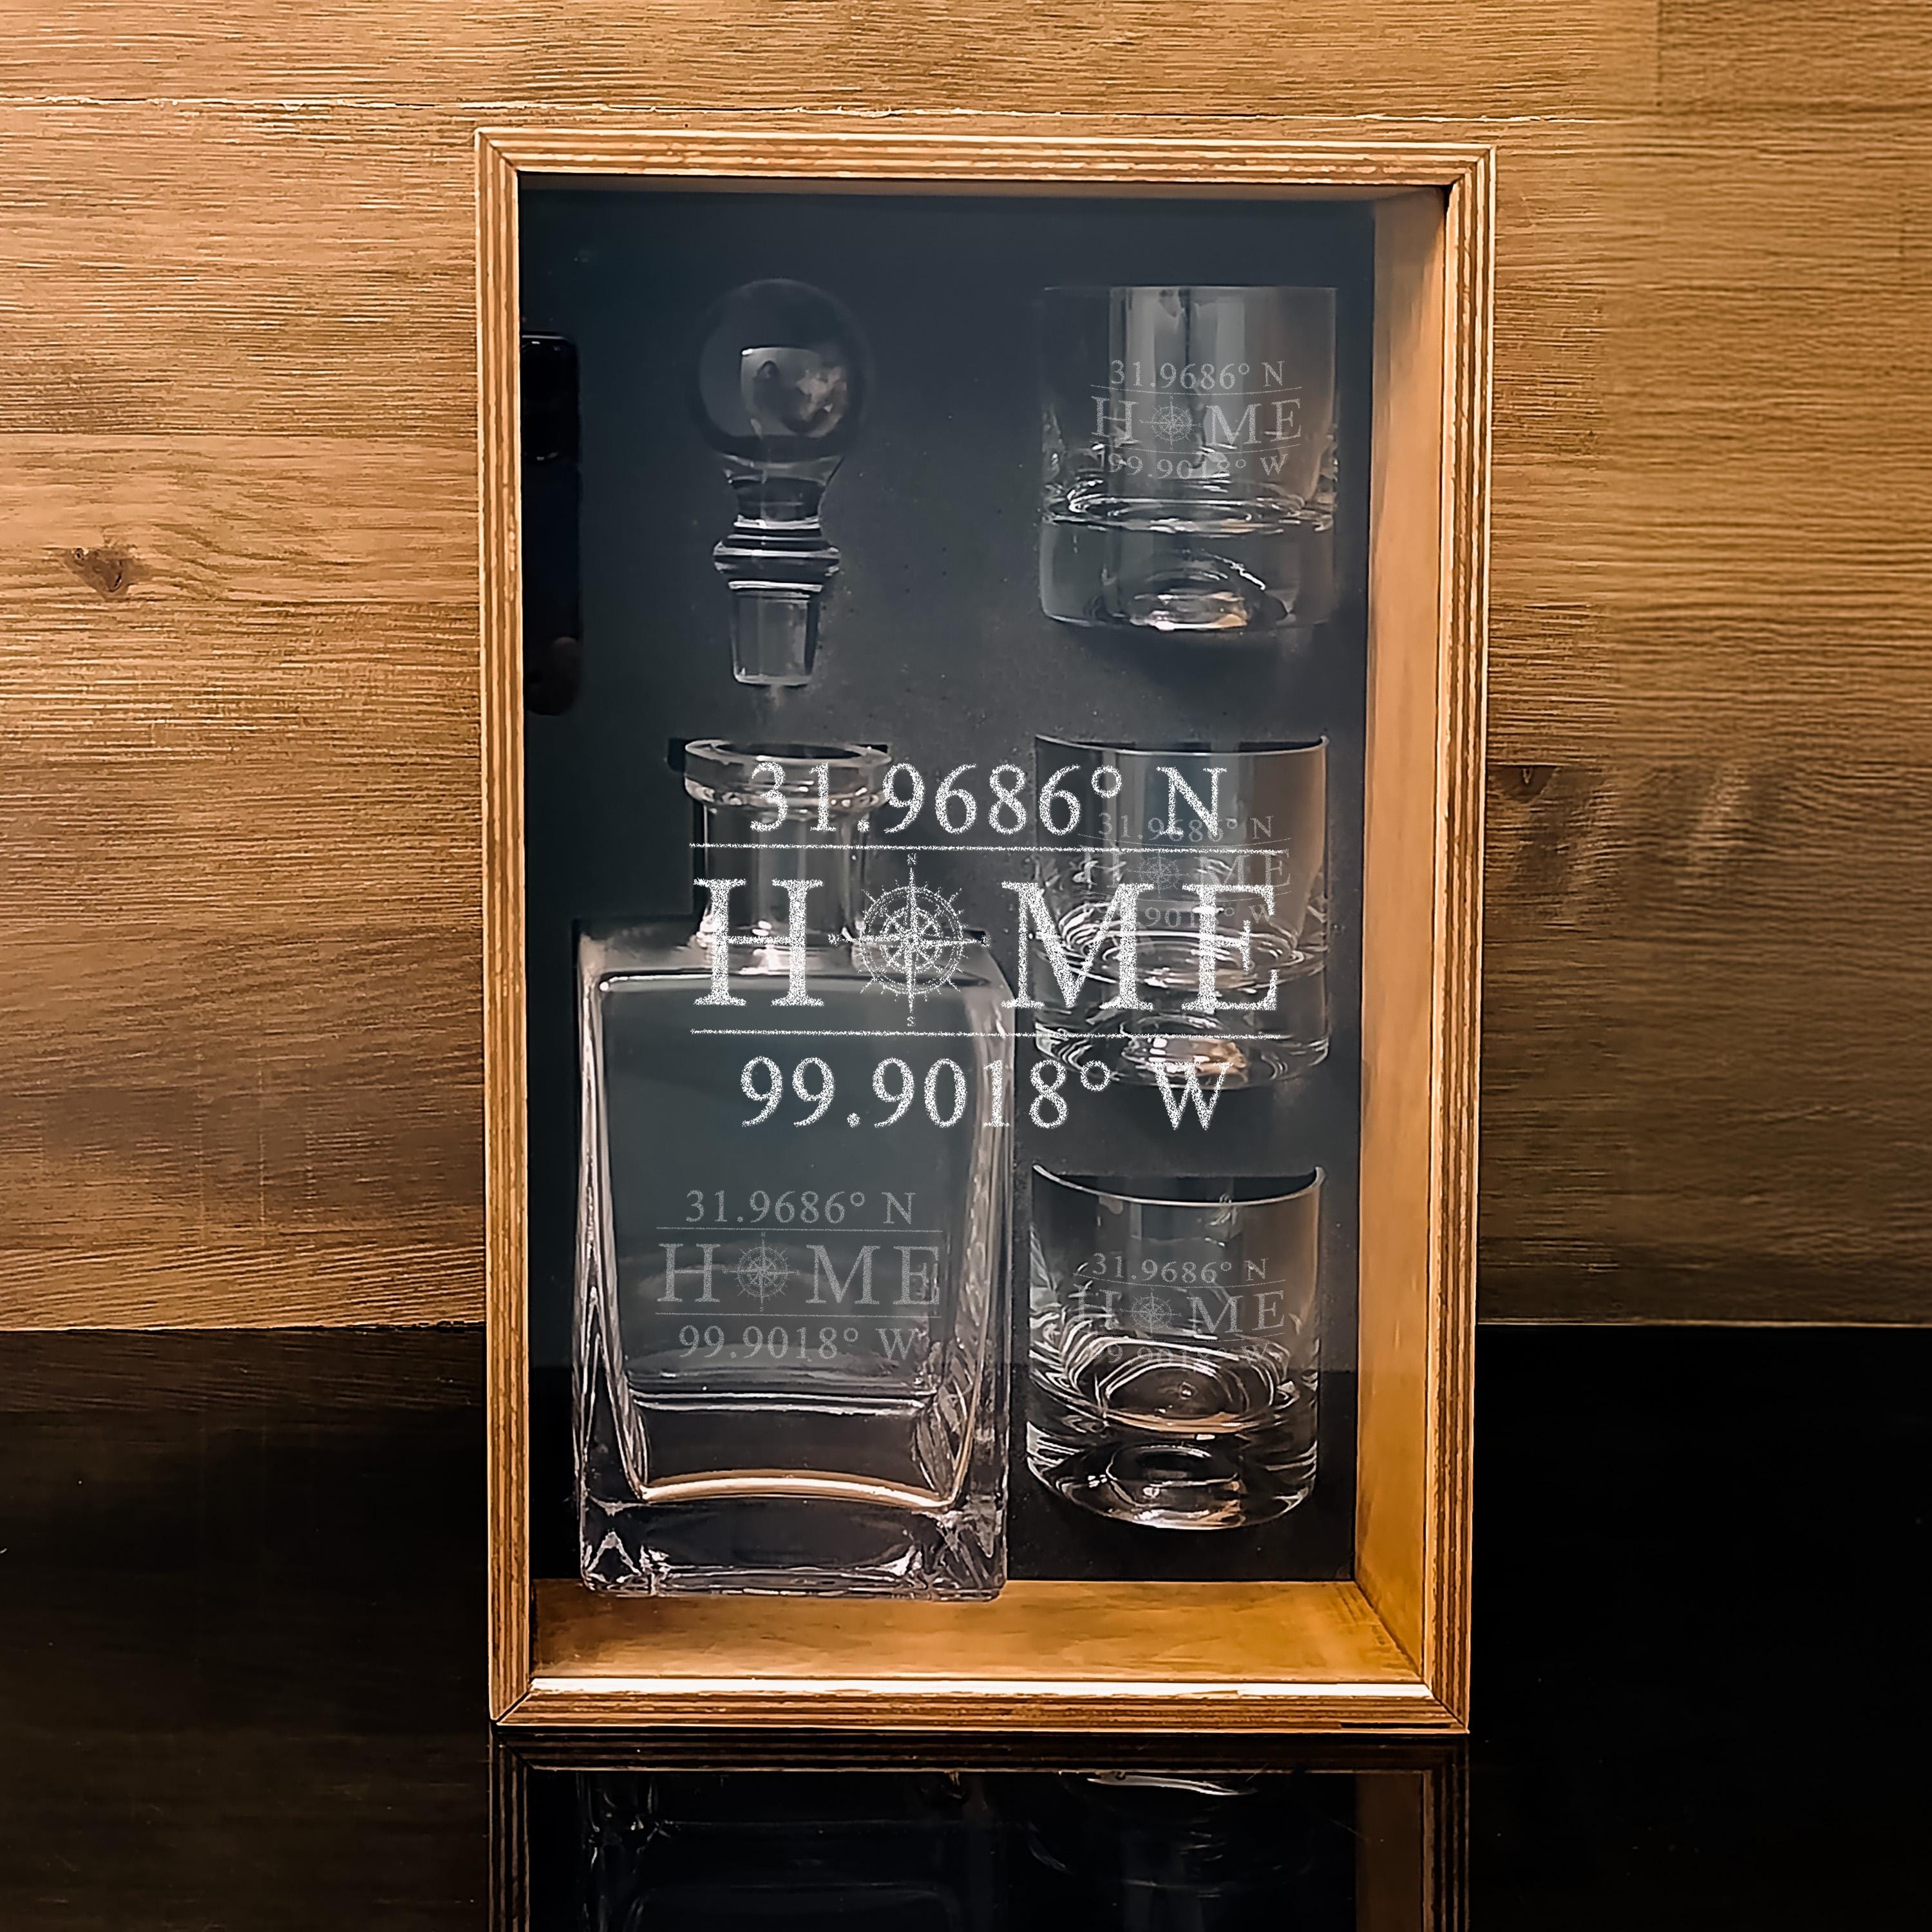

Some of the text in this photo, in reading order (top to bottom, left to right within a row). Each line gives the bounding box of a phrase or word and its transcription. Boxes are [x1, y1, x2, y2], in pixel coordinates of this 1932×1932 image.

[1111, 359, 1285, 390] 31.9686° N
[1260, 453, 1288, 476] W
[750, 762, 1227, 835] 31.9686° N
[1250, 815, 1274, 839] N
[741, 1055, 1235, 1130] 99.9018° W
[686, 1190, 916, 1224] 31.9686° N
[1092, 1253, 1269, 1283] 31.9686° N
[679, 1325, 918, 1360] 99.9018° W
[1242, 1343, 1269, 1365] W
